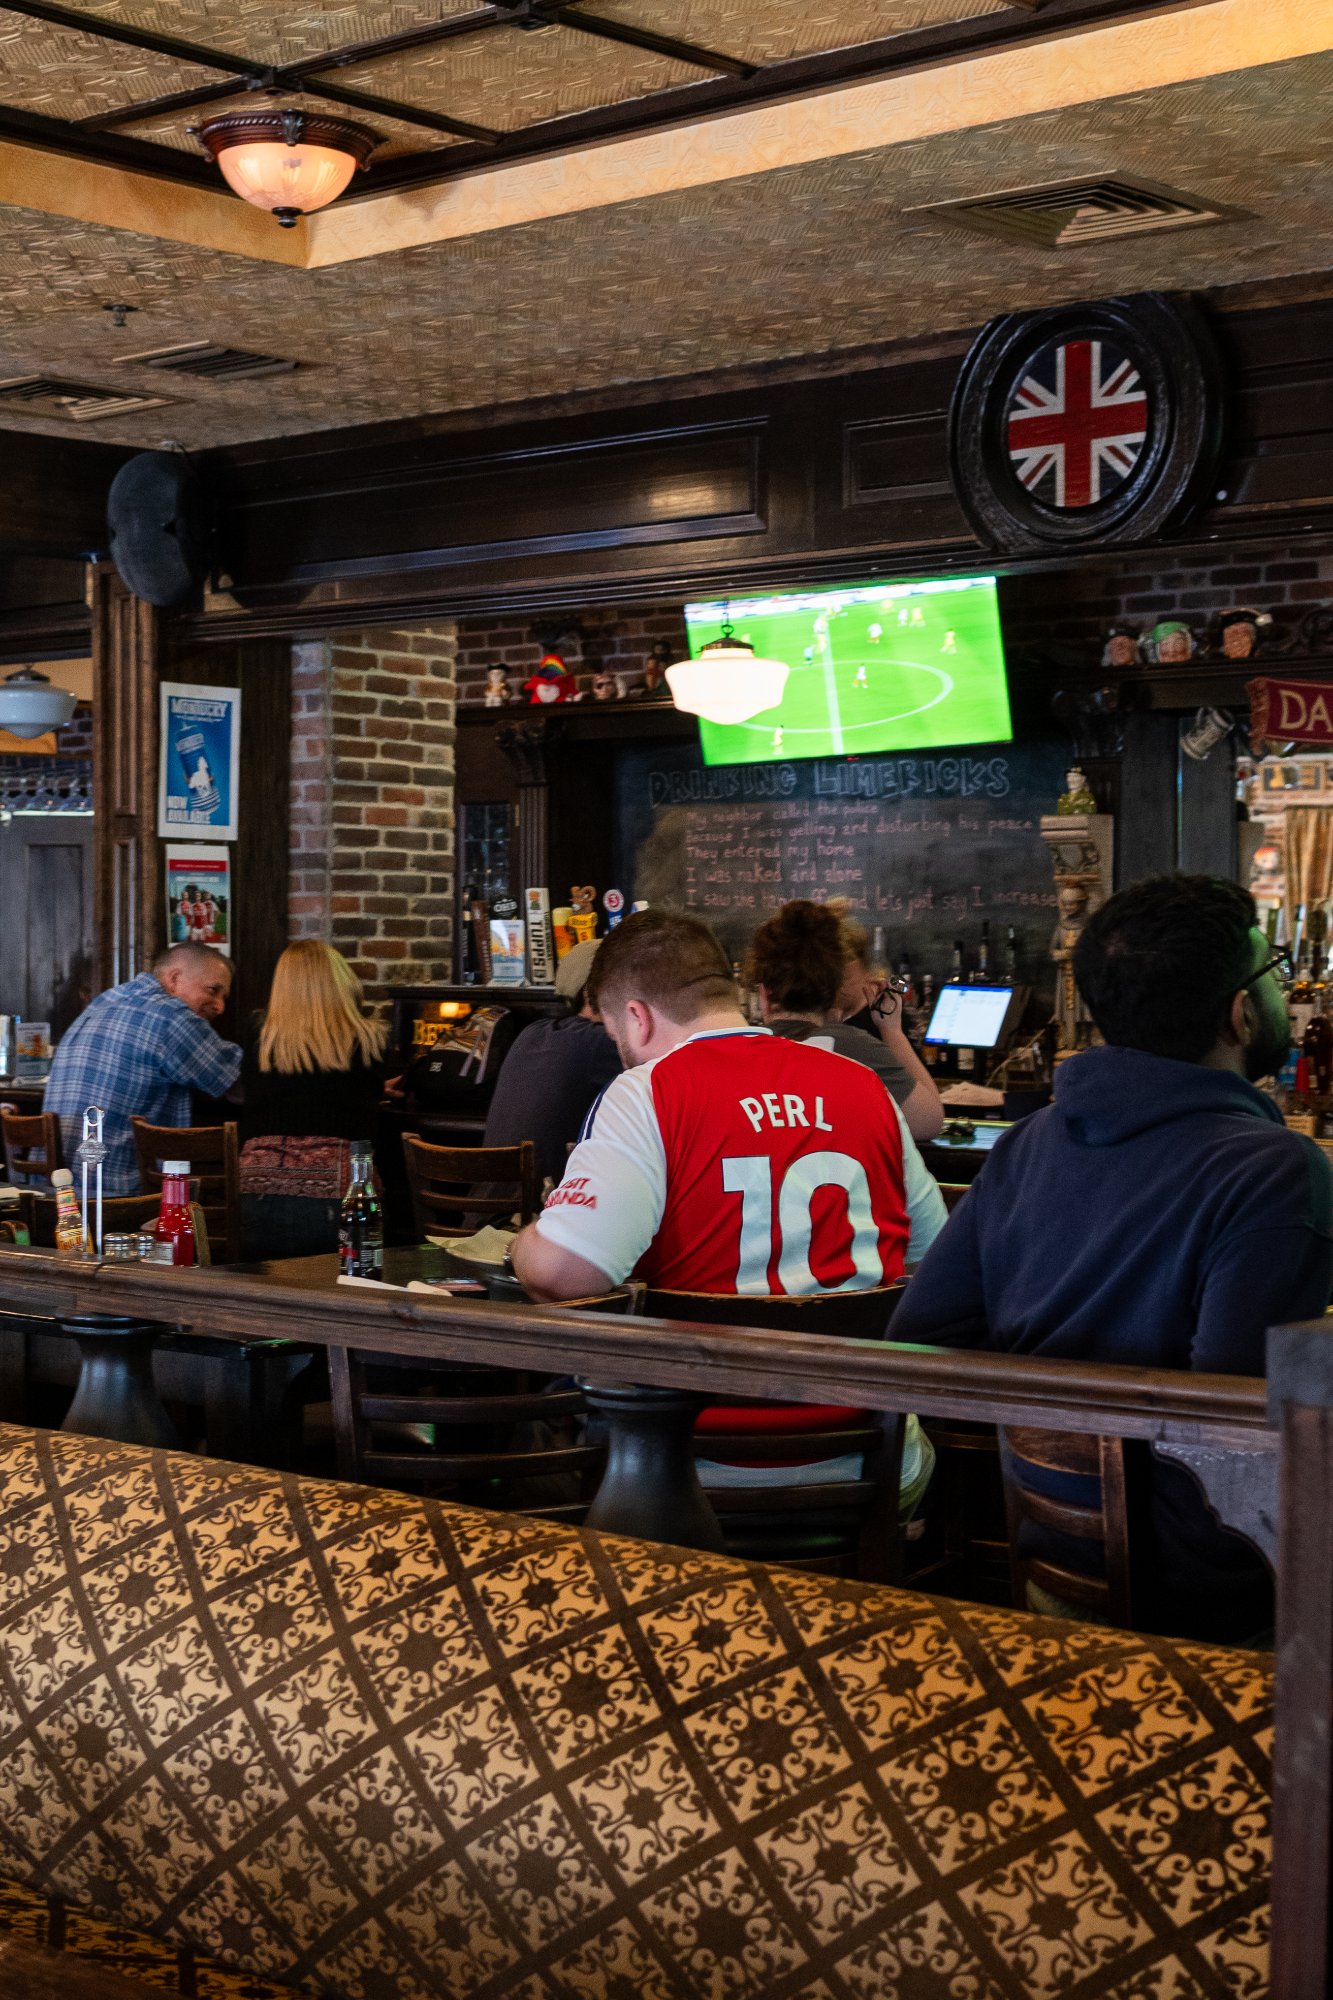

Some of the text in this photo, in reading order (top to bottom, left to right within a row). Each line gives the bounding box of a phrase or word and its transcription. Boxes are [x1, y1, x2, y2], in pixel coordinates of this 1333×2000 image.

[650, 757, 1010, 808] DRINKING LIMERICKS
[686, 812, 706, 831] My
[773, 800, 809, 820] called
[817, 800, 837, 816] the
[741, 827, 751, 840] I
[788, 821, 836, 844] yelling
[842, 817, 868, 836] and
[988, 819, 1032, 837] peace
[686, 838, 854, 866] They entered my home
[686, 861, 863, 884] I was naked and alone
[686, 889, 697, 907] I
[971, 886, 985, 907] I
[529, 920, 546, 967] TUPPS
[739, 1092, 832, 1133] PERL
[721, 1150, 884, 1295] 10
